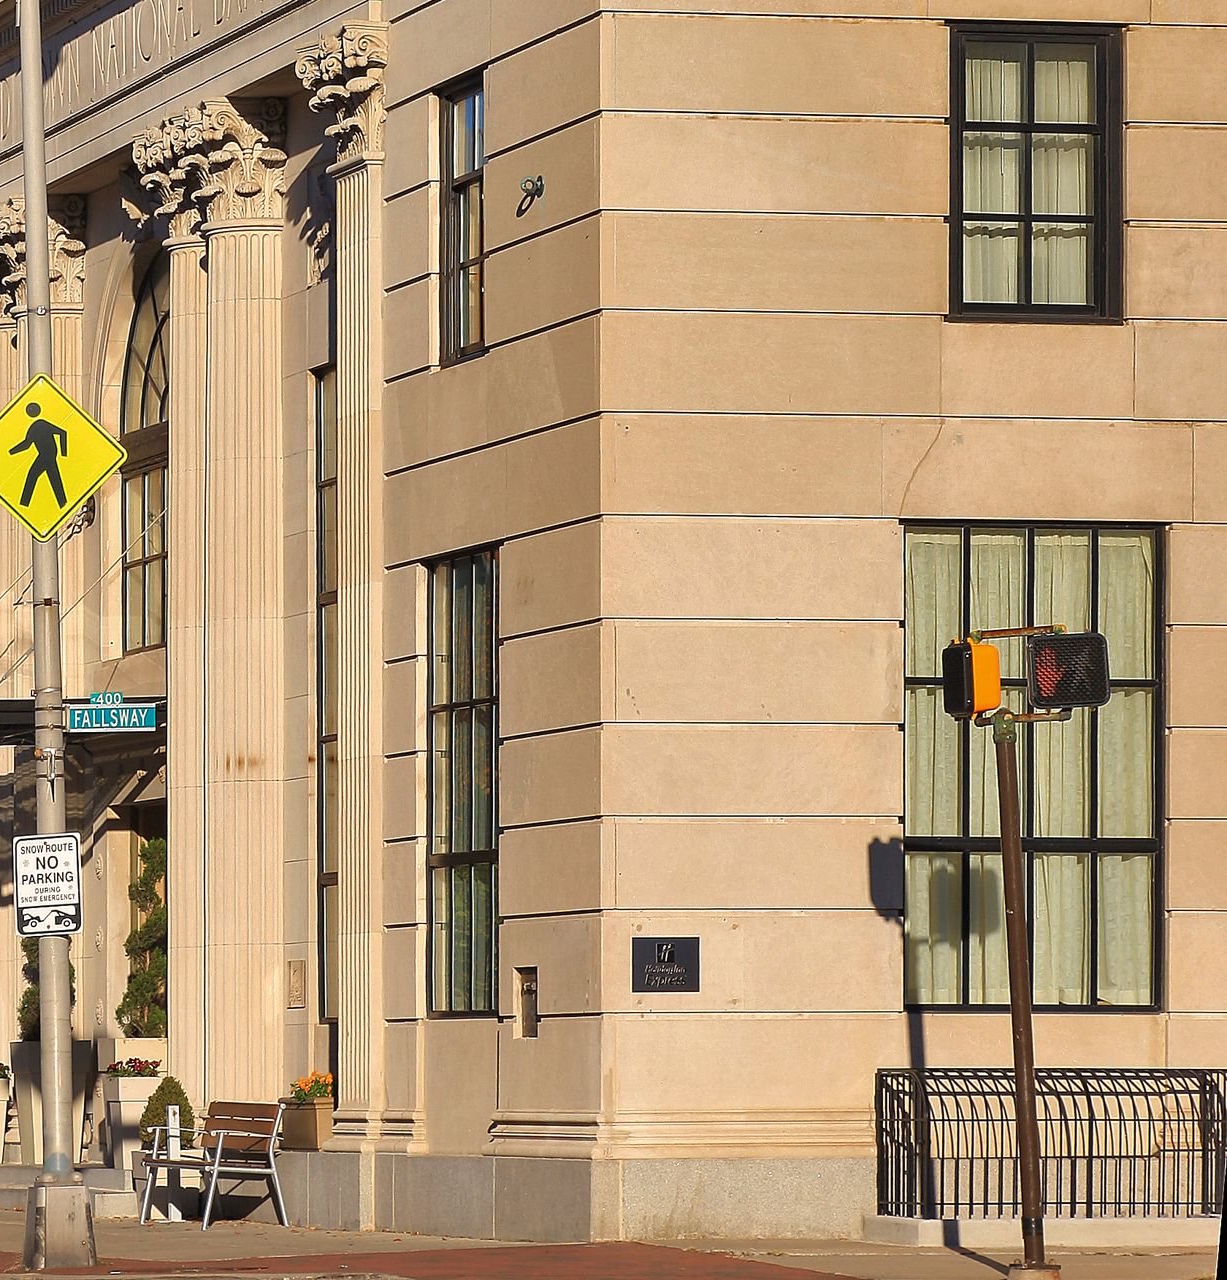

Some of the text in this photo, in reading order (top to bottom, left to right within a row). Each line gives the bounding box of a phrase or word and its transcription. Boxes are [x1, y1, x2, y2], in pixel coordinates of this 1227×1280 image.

[97, 692, 121, 706] 400
[74, 708, 148, 728] FALLSWAY
[20, 842, 74, 855] SNOW ROUTE
[36, 855, 59, 870] NO
[21, 871, 74, 886] PARKING
[34, 886, 61, 894] DURING
[39, 893, 76, 903] EMERGENCY
